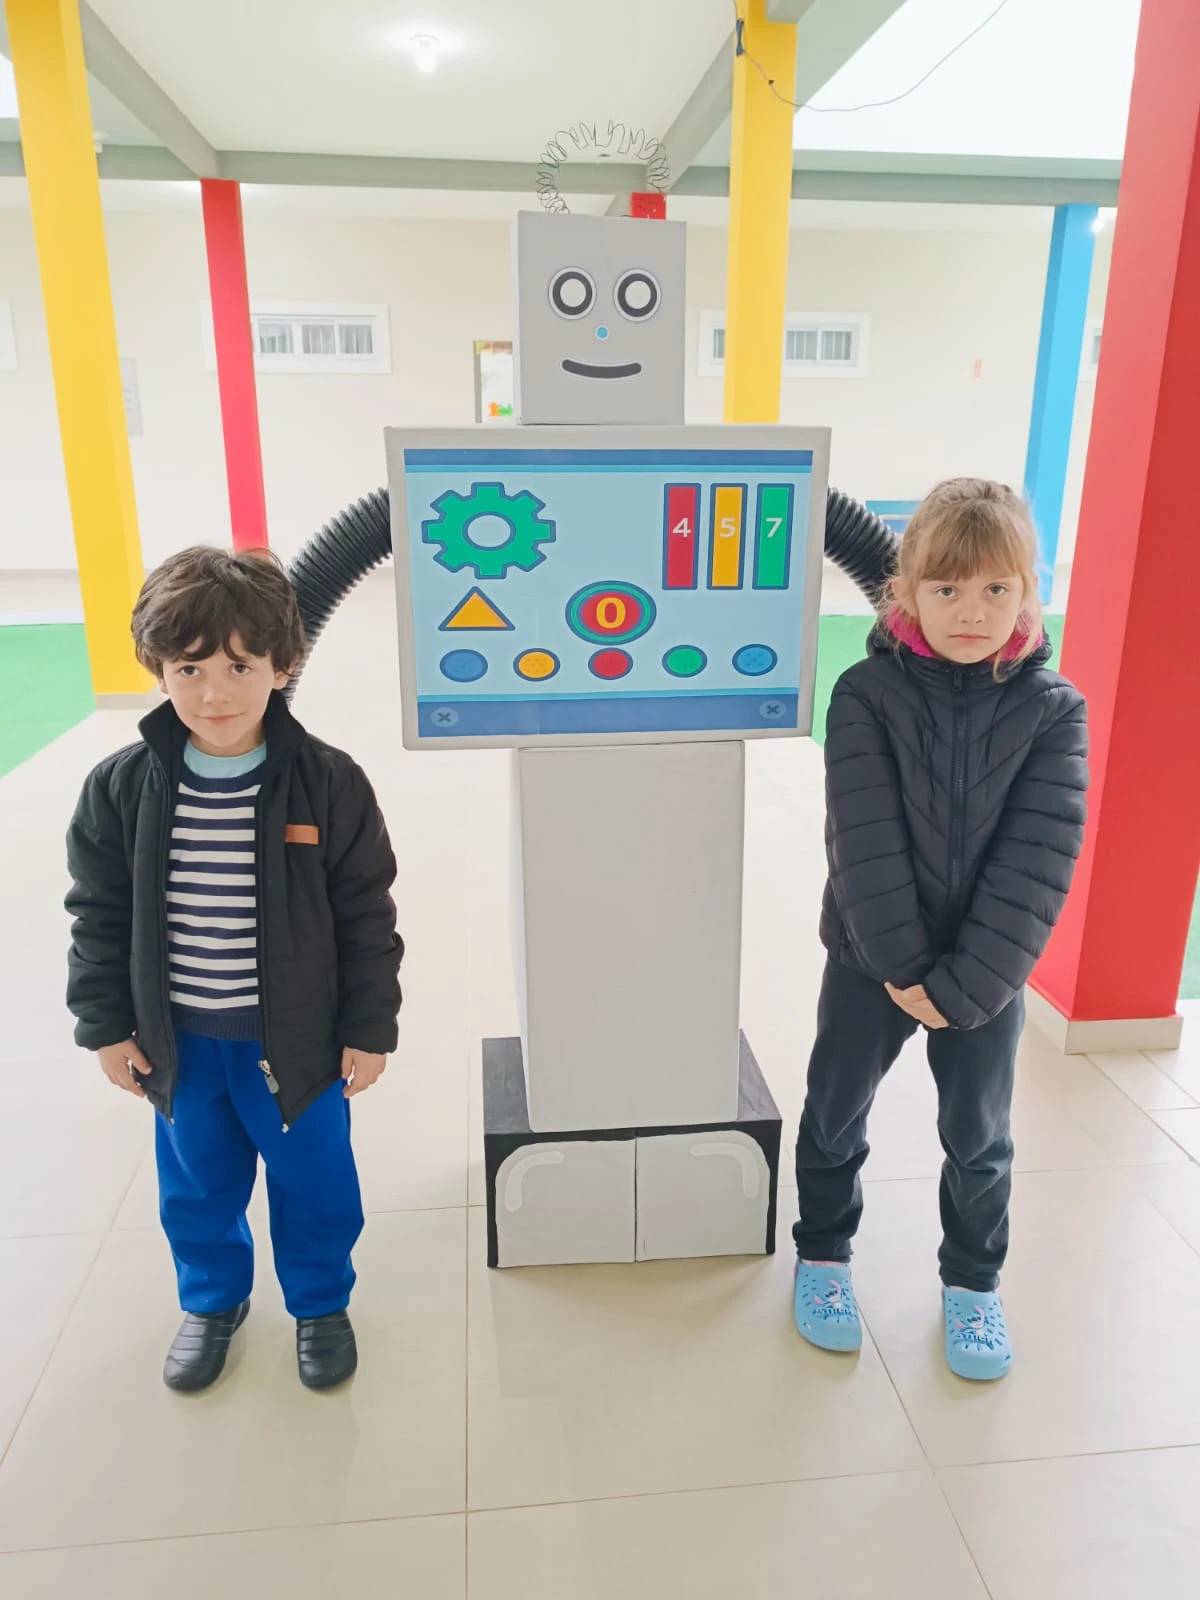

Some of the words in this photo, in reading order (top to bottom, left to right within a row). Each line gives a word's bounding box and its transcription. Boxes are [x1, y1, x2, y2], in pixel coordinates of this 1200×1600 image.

[672, 517, 692, 538] 4
[719, 517, 736, 538] 5
[765, 517, 783, 538] 7
